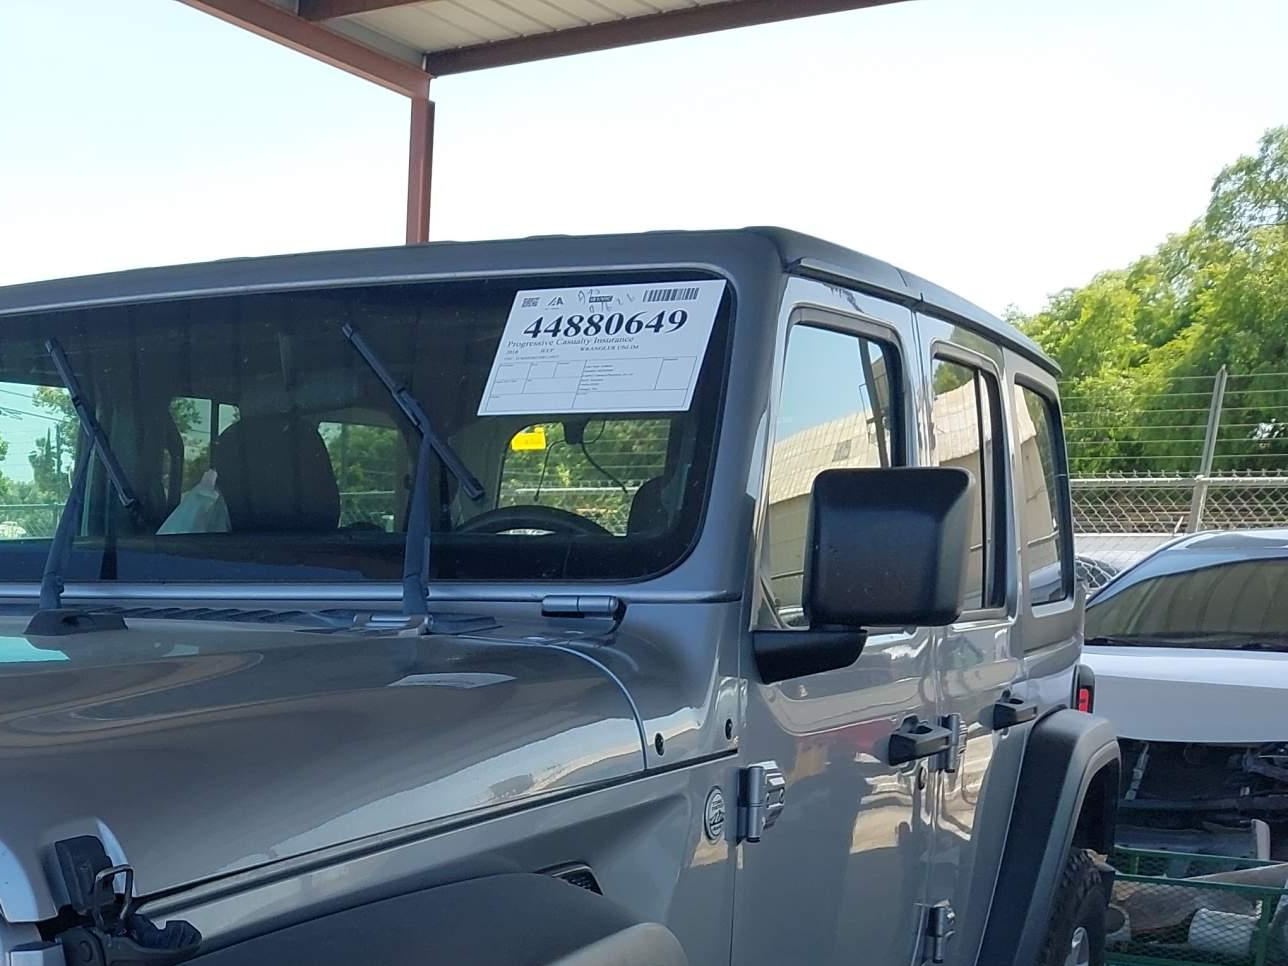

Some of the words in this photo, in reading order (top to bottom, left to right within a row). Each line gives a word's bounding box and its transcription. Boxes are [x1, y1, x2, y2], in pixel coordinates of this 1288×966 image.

[523, 309, 688, 339] 44880649
[508, 339, 554, 349] Progressive
[556, 338, 590, 346] Casualty
[593, 336, 635, 344] Insurance
